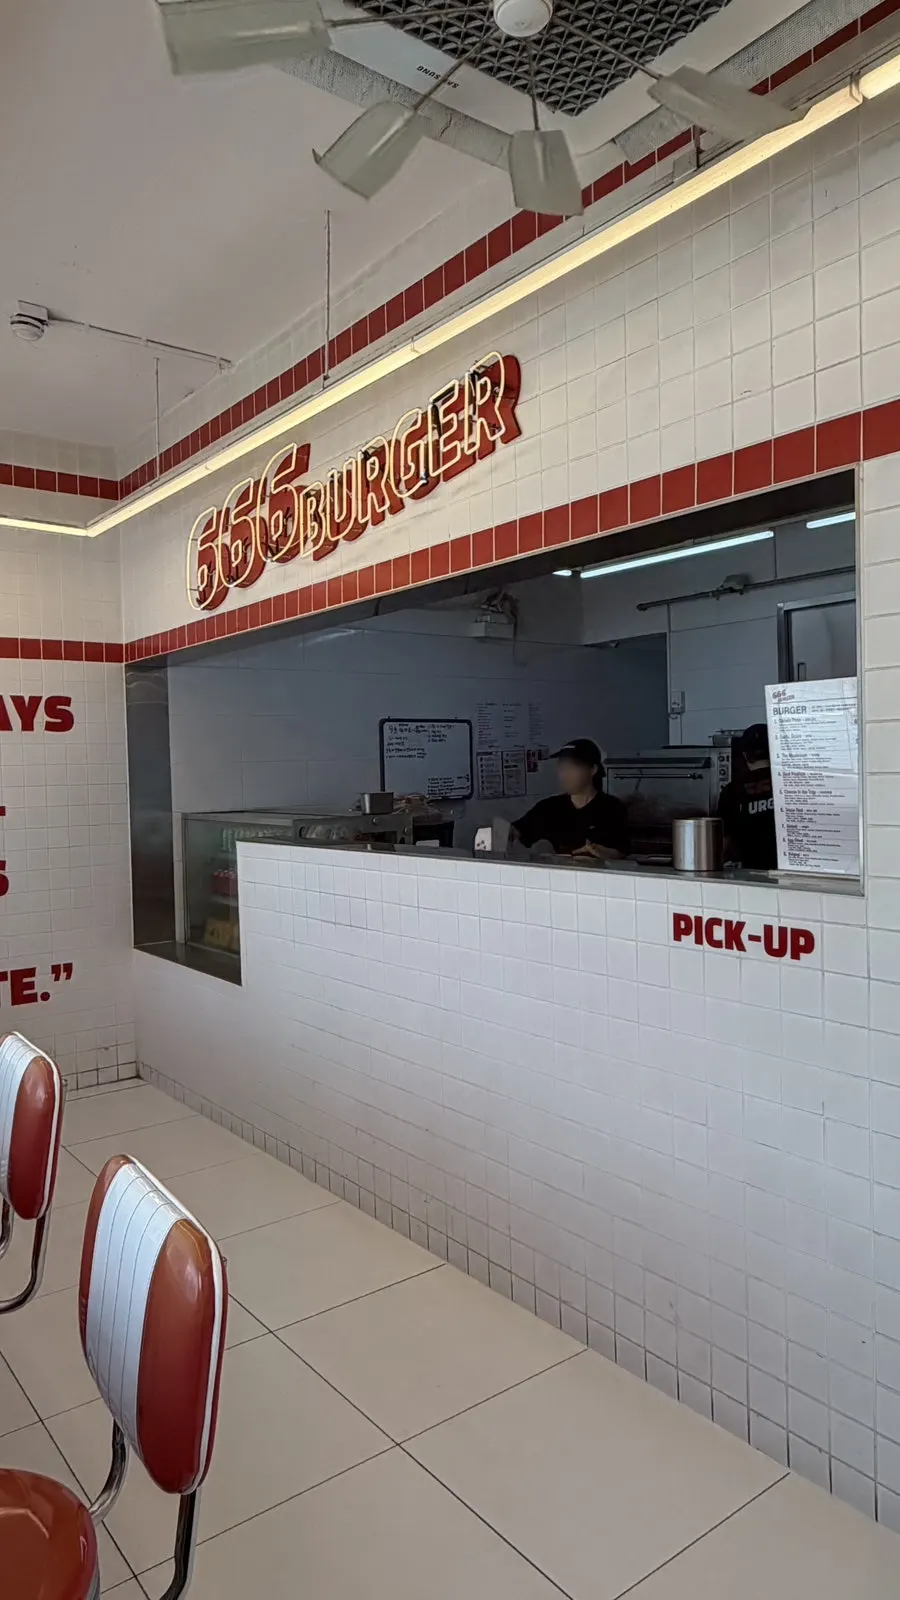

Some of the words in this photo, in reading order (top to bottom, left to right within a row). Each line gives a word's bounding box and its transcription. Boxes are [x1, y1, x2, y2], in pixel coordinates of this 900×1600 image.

[416, 65, 460, 89] SASUNG
[186, 443, 310, 611] 666
[300, 351, 523, 561] BURGER
[773, 705, 807, 716] BURGER
[673, 912, 815, 961] PICK-UP
